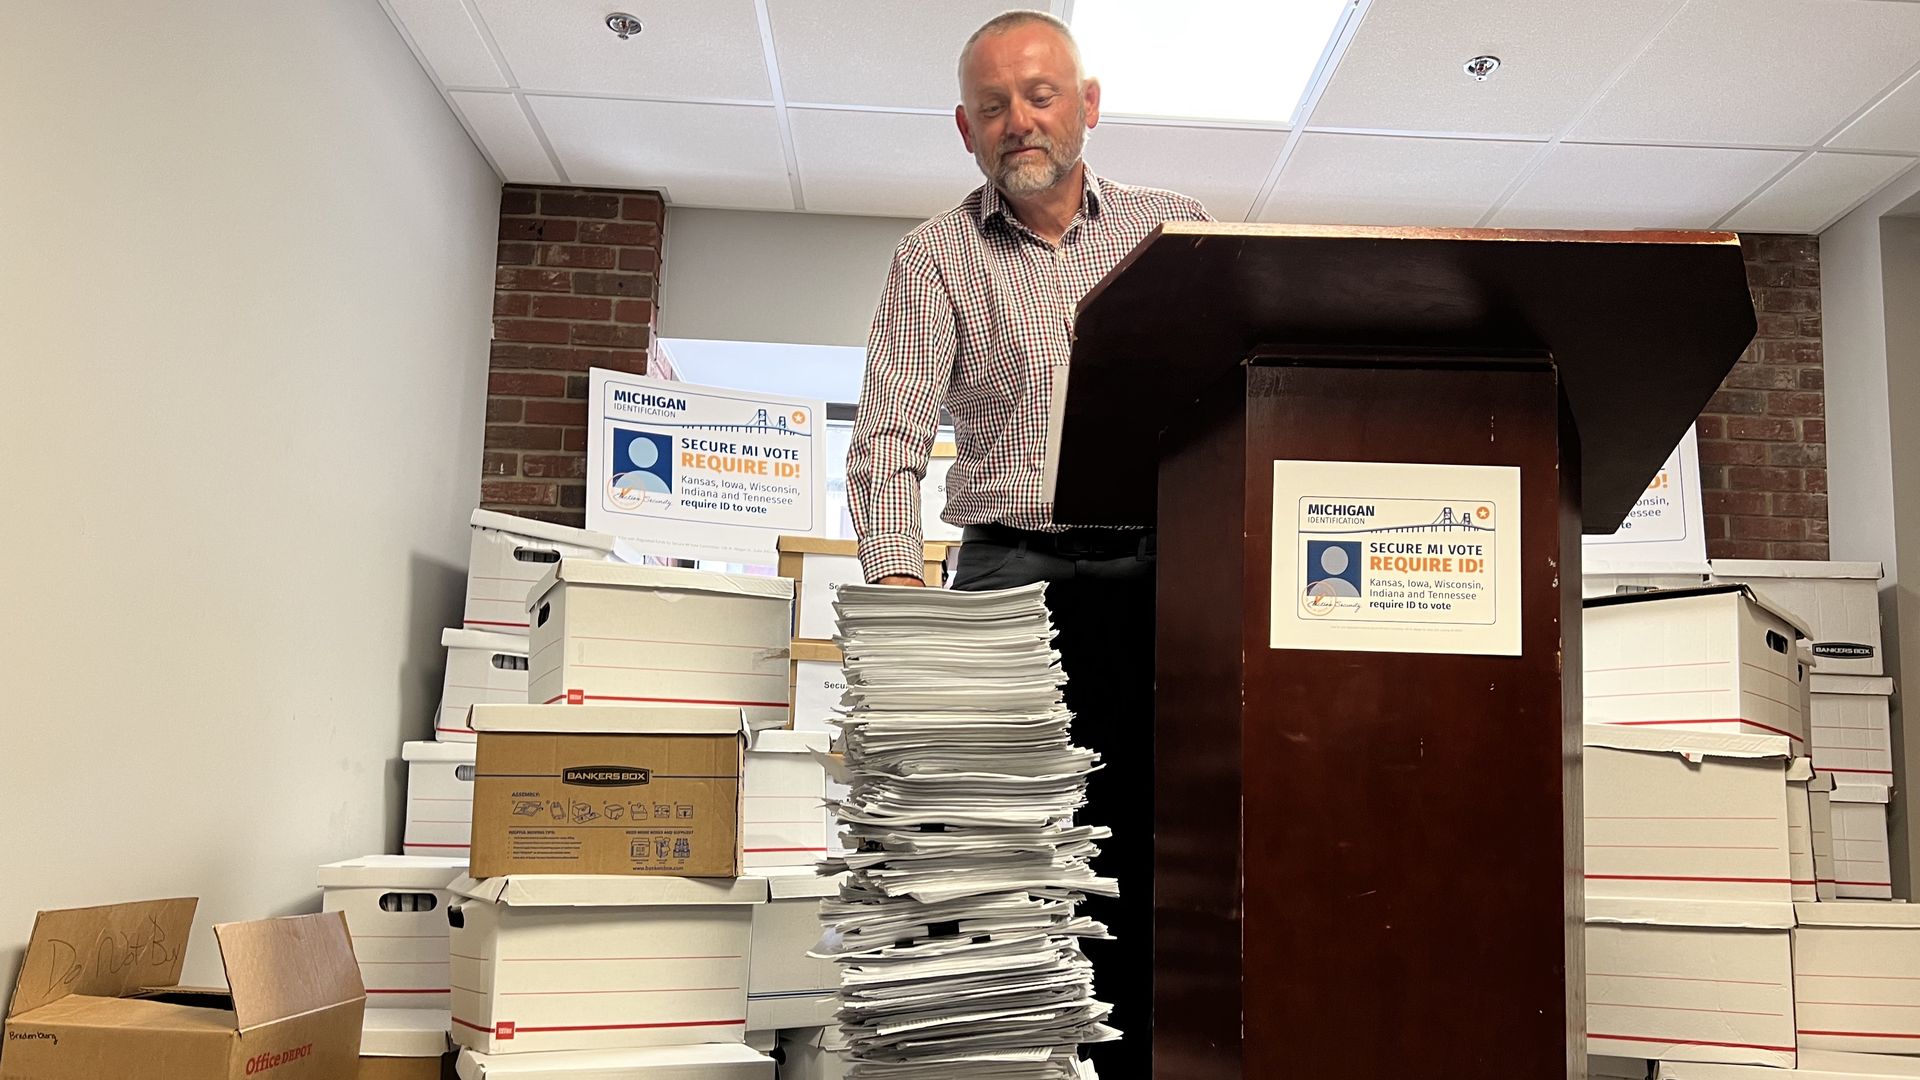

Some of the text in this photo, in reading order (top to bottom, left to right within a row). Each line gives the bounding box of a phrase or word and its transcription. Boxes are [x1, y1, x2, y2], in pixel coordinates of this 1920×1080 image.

[614, 390, 686, 411] MICHIGAN
[614, 402, 676, 418] IDENTIFICATION
[681, 438, 799, 460] SECURE MI VOTE
[681, 452, 800, 478] REQUIRE ID!
[681, 475, 801, 496] Kansas, Iowa, Wisconsin,
[1648, 473, 1668, 489] D!
[681, 486, 793, 505] Indiana and Tennessee
[1635, 496, 1669, 506] onsin,
[681, 499, 767, 514] require ID to vote
[1308, 504, 1375, 516] MICHIGAN
[1628, 509, 1662, 518] essee
[1307, 516, 1365, 525] IDENTIFICATION
[1370, 542, 1483, 556] SECURE MI VOTE
[1370, 556, 1484, 574] REQUIRE ID!
[1369, 578, 1484, 591] Kansas, Iowa, Wisconsin,
[1369, 589, 1477, 600] Indiana and Tennessee
[1369, 600, 1404, 610] require
[1406, 601, 1416, 609] ID
[1418, 602, 1428, 610] to
[1815, 646, 1853, 654] BANKERS
[824, 681, 848, 689] Secu
[567, 772, 646, 780] BANKERS BOX
[42, 938, 83, 998] Do
[96, 927, 144, 977] Not
[245, 1043, 313, 1076] Office DEPOT
